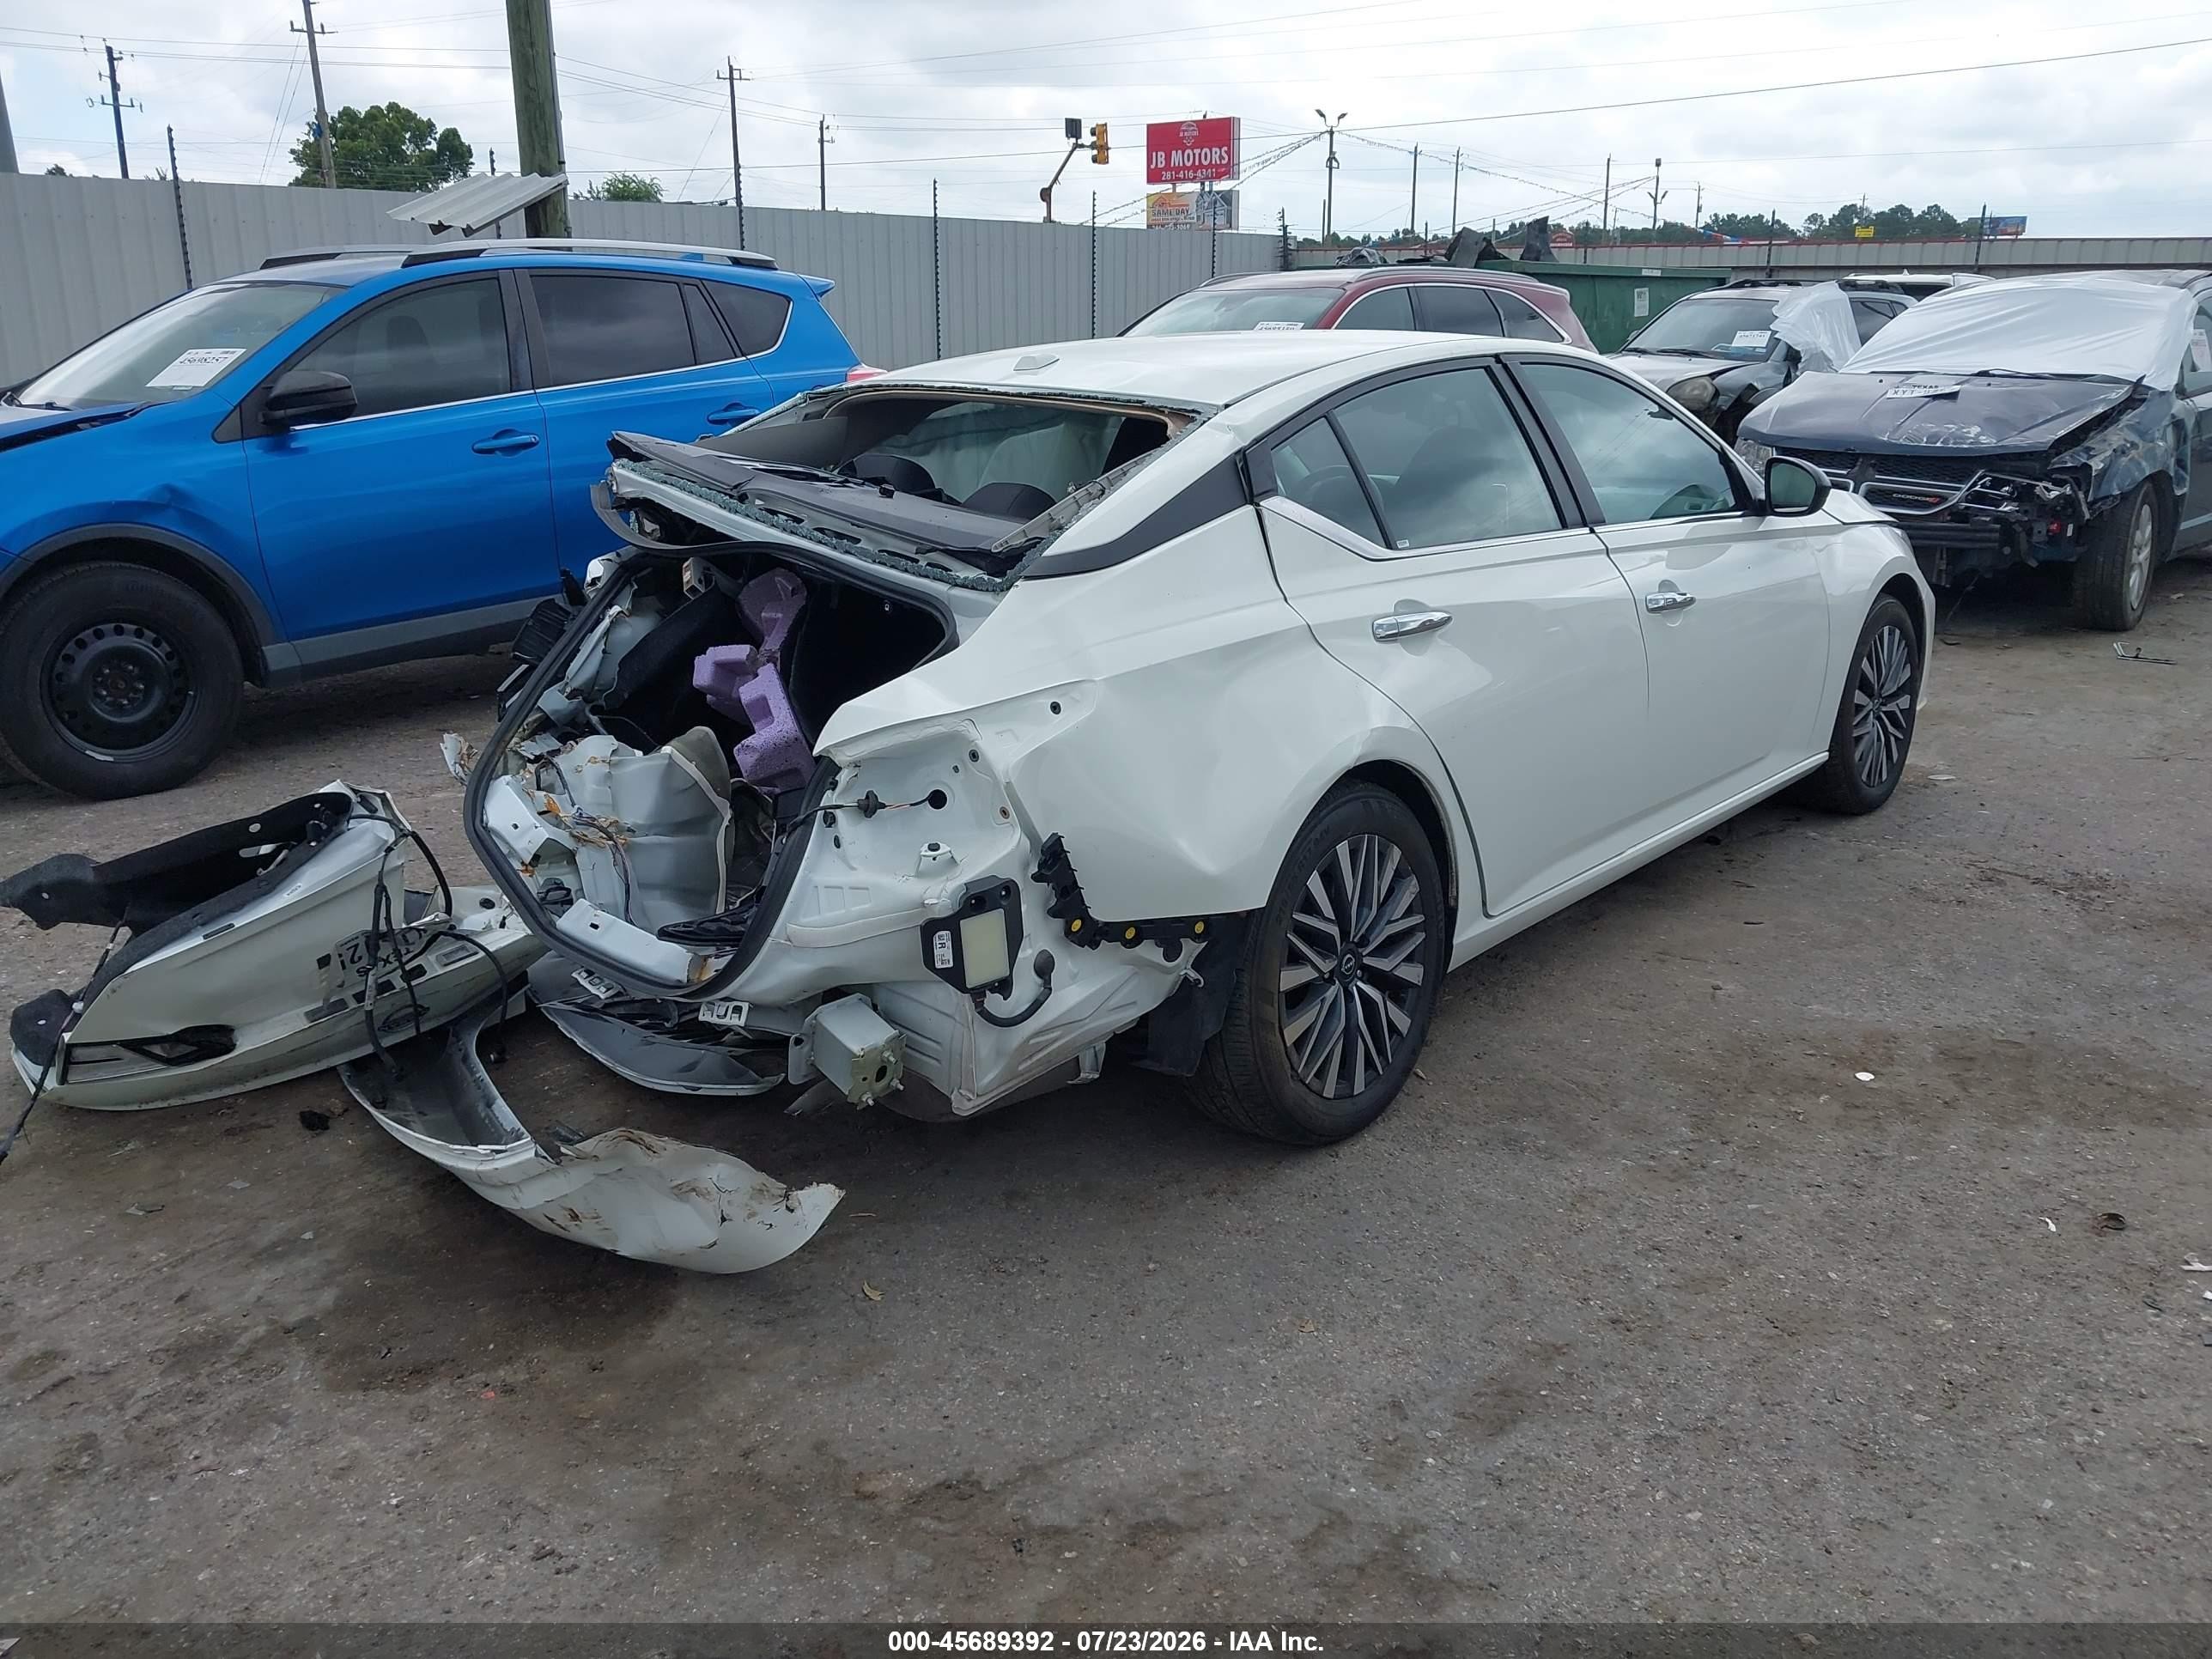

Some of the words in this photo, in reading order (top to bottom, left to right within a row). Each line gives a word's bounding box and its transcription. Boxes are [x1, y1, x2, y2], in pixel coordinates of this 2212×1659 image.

[1151, 151, 1165, 168] JB
[1170, 147, 1229, 167] MOTORS
[1175, 206, 1190, 216] DAY
